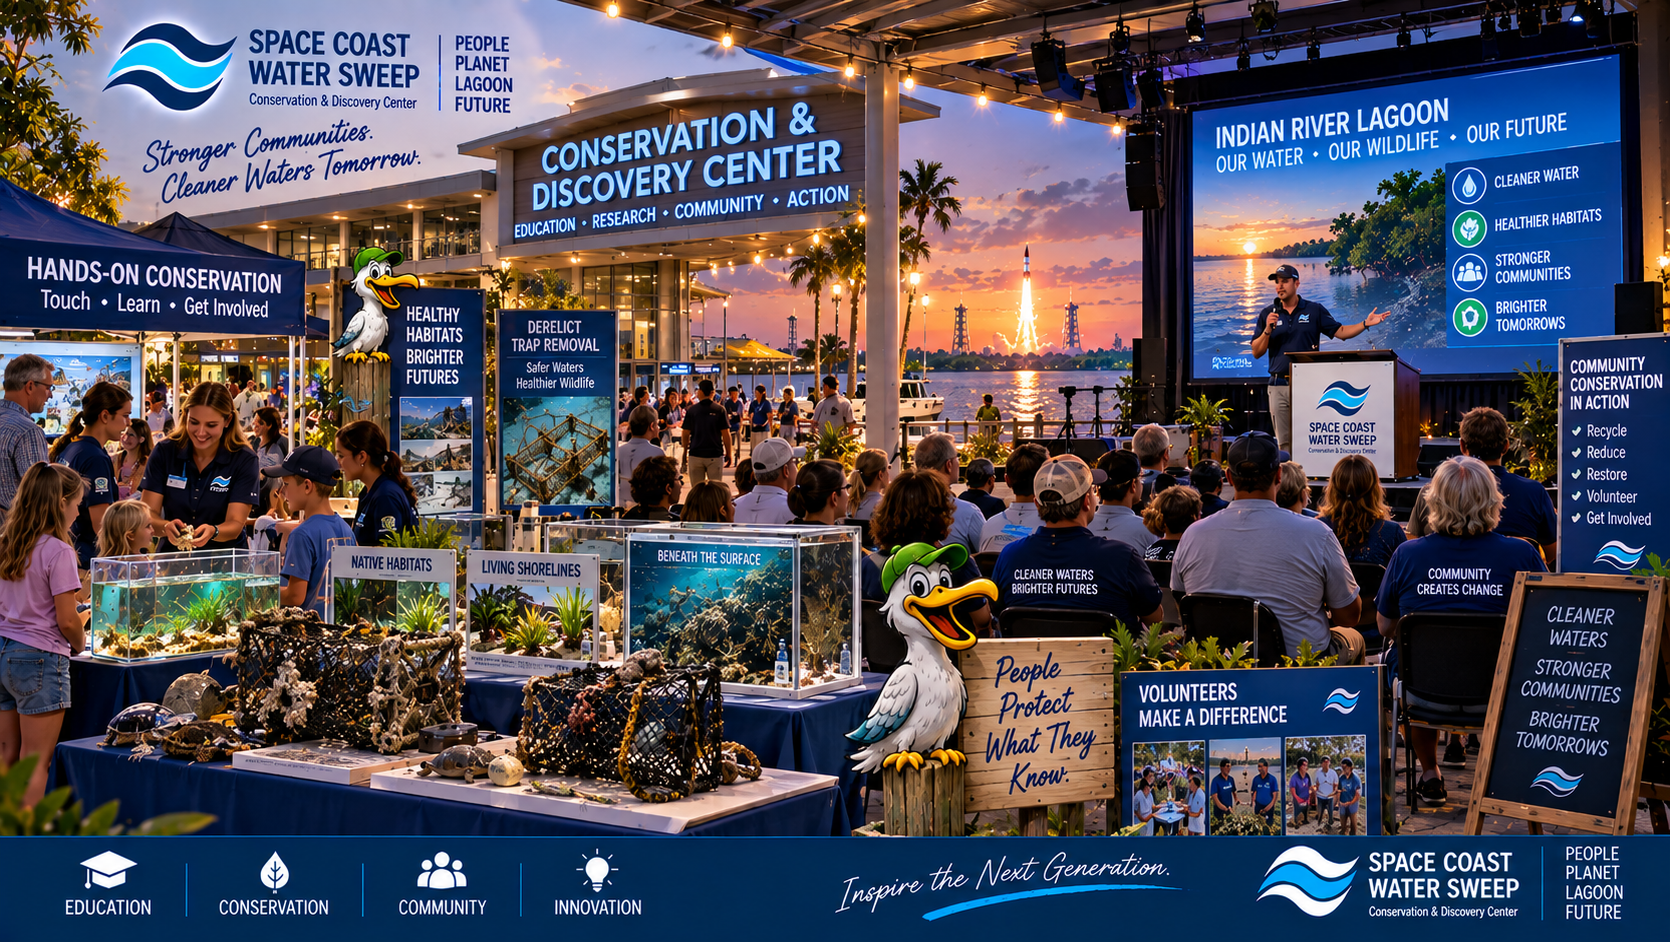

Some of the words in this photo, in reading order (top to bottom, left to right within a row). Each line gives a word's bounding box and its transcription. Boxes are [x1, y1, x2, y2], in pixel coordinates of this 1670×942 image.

[1216, 120, 1284, 149] INDIAN
[1290, 111, 1349, 141] RIVER
[1357, 97, 1450, 133] LAGOON
[541, 107, 775, 174] CONSERVATION
[789, 101, 817, 136] &
[1216, 153, 1248, 174] OUR
[1251, 147, 1303, 170] WATER
[1329, 141, 1363, 161] OUR
[1367, 130, 1439, 158] WILDLIFE
[1466, 123, 1500, 144] OUR
[1505, 112, 1567, 139] FUTURE
[532, 159, 693, 211] DISCOVERY
[703, 139, 842, 188] CENTER
[1494, 170, 1539, 189] CLEANER
[1542, 166, 1579, 184] WATER
[514, 217, 576, 238] EDUCATION
[592, 207, 656, 229] RESEARCH
[674, 194, 764, 219] COMMUNITY
[787, 185, 849, 208] ACTION
[1494, 214, 1548, 232] HEALTHIER
[1552, 209, 1602, 226] HABITATS
[1495, 250, 1551, 266] STRONGER
[27, 256, 139, 286] HANDS-ON
[146, 263, 282, 294] CONSERVATION
[1495, 266, 1571, 284] COMMUNITIES
[40, 289, 90, 310] Touch
[117, 293, 160, 313] Learn
[184, 297, 208, 316] Get
[213, 298, 268, 319] Involved
[1495, 299, 1547, 315] BRIGHTER
[406, 306, 460, 323] HEALTHY
[528, 320, 582, 334] DERELICT
[1495, 316, 1565, 332] TOMORROWS
[406, 327, 463, 343] HABITATS
[512, 338, 541, 352] TRAP
[544, 338, 600, 352] REMOVAL
[406, 349, 463, 365] BRIGHTER
[1570, 356, 1645, 374] COMMUNITY
[526, 362, 550, 374] Safer
[552, 362, 584, 373] Waters
[406, 369, 459, 385] FUTURES
[516, 377, 557, 389] Healthier
[559, 377, 595, 390] Wildlife
[1570, 374, 1663, 392] CONSERVATION
[1570, 395, 1582, 410] IN
[1585, 394, 1629, 410] ACTION
[1309, 422, 1339, 433] SPACE
[1343, 422, 1375, 433] COAST
[1587, 424, 1627, 439] Recycle
[1308, 435, 1340, 445] WATER
[1343, 435, 1377, 445] SWEEP
[1587, 446, 1626, 459] Reduce
[1587, 468, 1627, 481] Restore
[1587, 489, 1637, 504] Volunteer
[1587, 511, 1605, 525] Get
[1608, 511, 1651, 526] Involved
[351, 555, 384, 570] NATIVE
[386, 557, 432, 572] HABITATS
[658, 549, 696, 565] BENEATH
[700, 551, 717, 566] THE
[720, 551, 761, 566] SURFACE
[482, 560, 515, 575] LIVING
[517, 561, 581, 577] SHORELINES
[1014, 569, 1053, 581] CLEANER
[1056, 569, 1094, 582] WATERS
[1428, 567, 1491, 580] COMMUNITY
[1012, 583, 1053, 595] BRIGHTER
[1056, 583, 1098, 595] FUTURES
[1417, 582, 1460, 595] CREATES
[1462, 582, 1503, 596] CHANGE
[1547, 605, 1614, 626] CLEANER
[1550, 629, 1607, 649] WATERS
[995, 652, 1061, 692] People
[1535, 658, 1611, 680] STRONGER
[1139, 683, 1237, 703] VOLUNTEERS
[1520, 680, 1621, 704] COMMUNITIES
[999, 687, 1074, 724] Protect
[1139, 707, 1181, 727] MAKE
[1183, 708, 1196, 726] A
[1199, 705, 1287, 726] DIFFERENCE
[1529, 710, 1600, 733] BRIGHTER
[985, 731, 1040, 763] What
[1047, 721, 1096, 760] They
[1516, 731, 1608, 757] TOMORROWS
[1008, 763, 1069, 795] Know.
